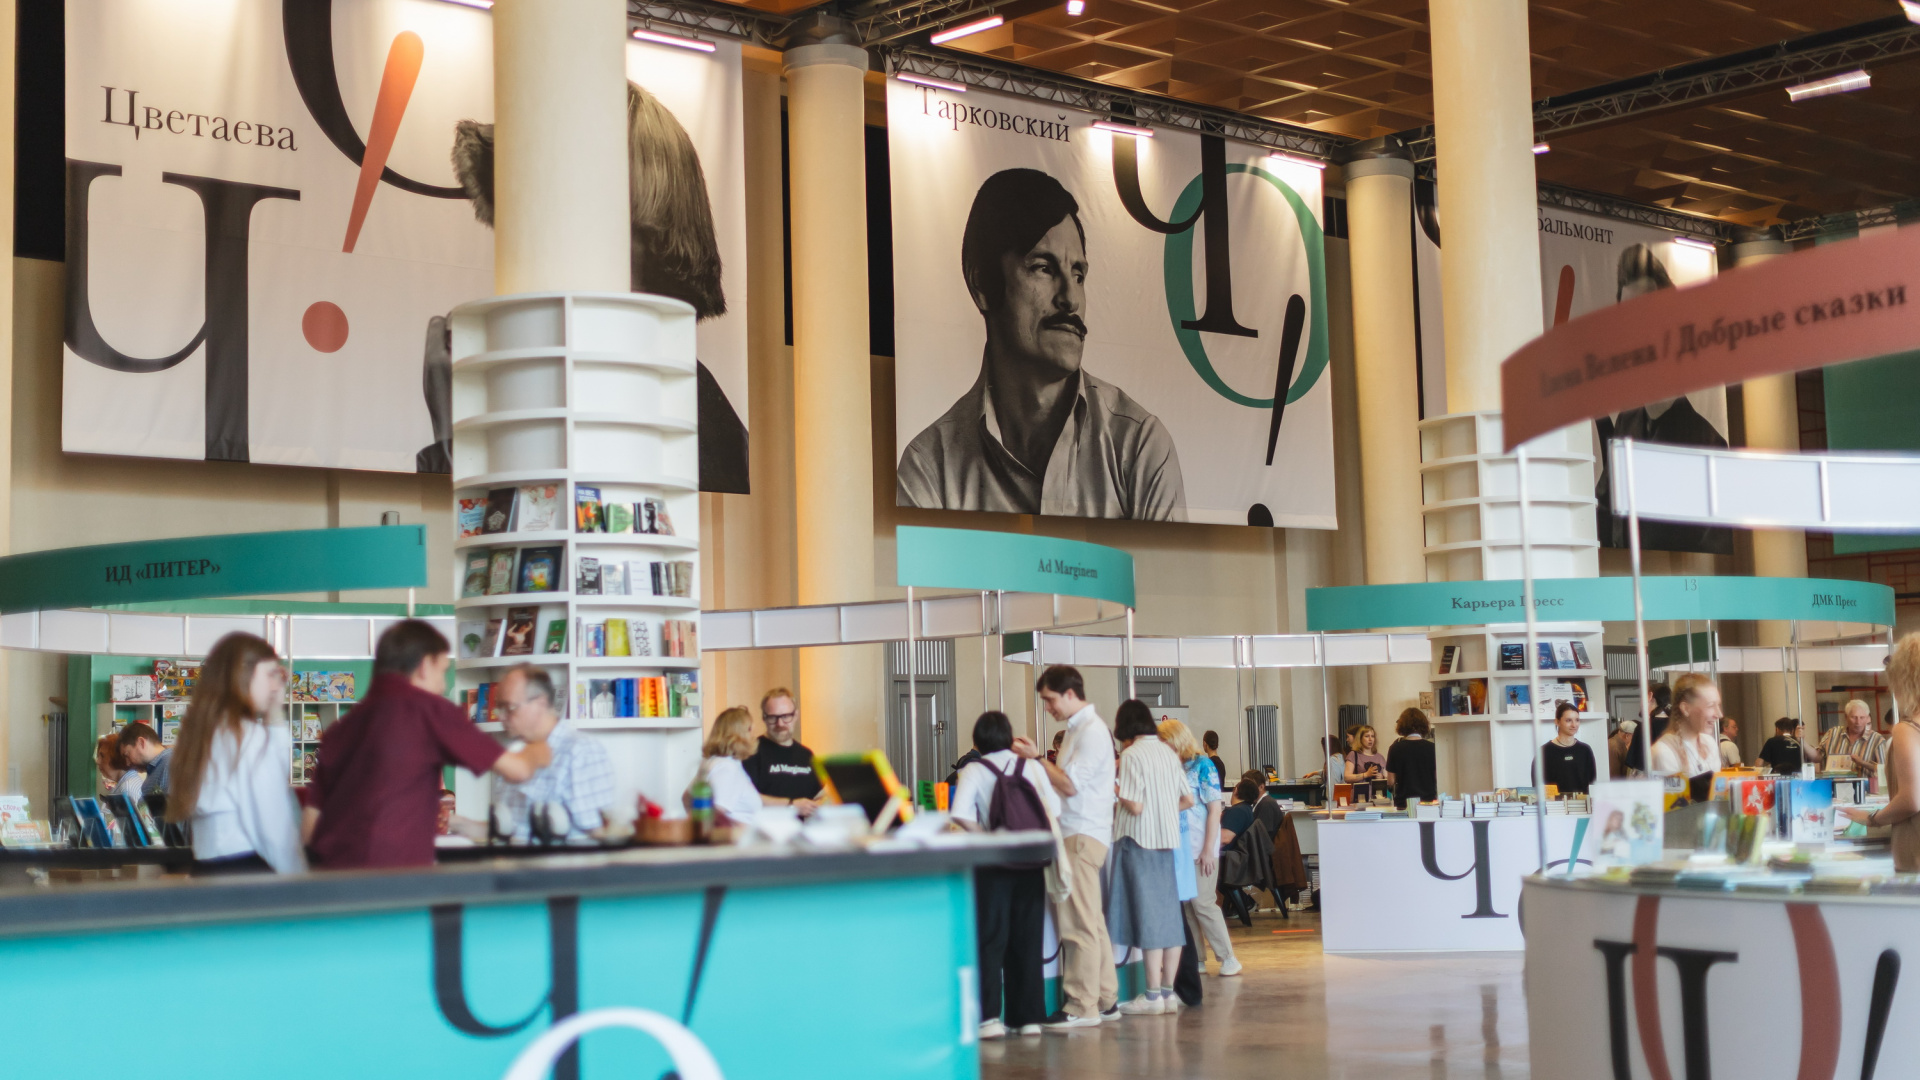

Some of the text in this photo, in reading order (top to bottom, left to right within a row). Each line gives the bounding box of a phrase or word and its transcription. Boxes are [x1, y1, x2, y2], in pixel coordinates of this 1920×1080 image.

[100, 85, 298, 155] Цветаева
[915, 84, 1071, 143] Тарковский
[1677, 310, 1785, 363] Добрые
[1794, 283, 1907, 326] сказки
[105, 558, 221, 586] ИД «ПИТЕР»
[1037, 558, 1099, 582] Ad Marginem
[1451, 596, 1515, 611] Карьера
[1812, 594, 1858, 609] ДМК Пресс
[769, 764, 780, 773] Ad
